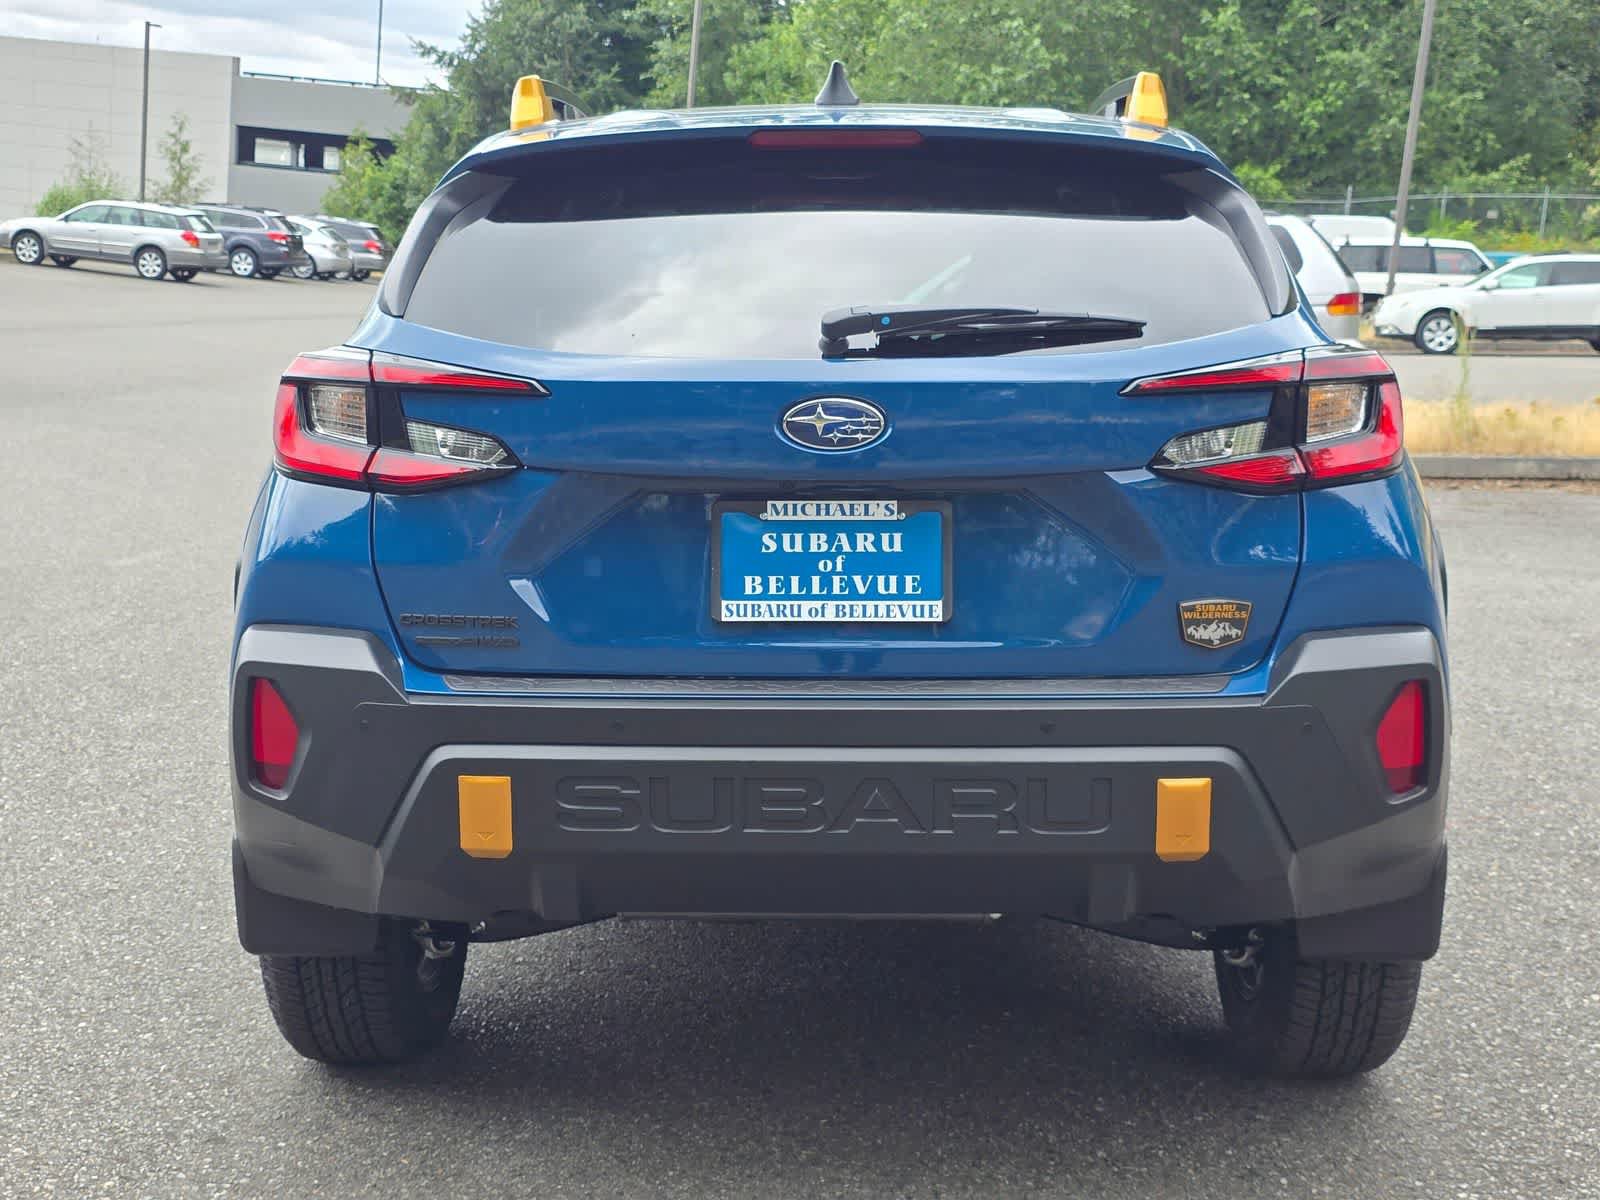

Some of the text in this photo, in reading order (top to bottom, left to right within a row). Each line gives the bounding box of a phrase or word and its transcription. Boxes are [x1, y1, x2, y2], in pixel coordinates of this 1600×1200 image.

[770, 502, 896, 517] MICHAEL'S
[761, 532, 903, 553] SUBARU
[818, 555, 845, 572] of
[744, 575, 922, 595] BELLEVUE
[724, 603, 939, 619] SUBARU of BELLEVUE
[1184, 611, 1248, 619] WILDERNESS
[1195, 604, 1236, 612] SUBARU
[400, 613, 519, 628] CROSSTREK
[555, 776, 1113, 835] SUBARU
